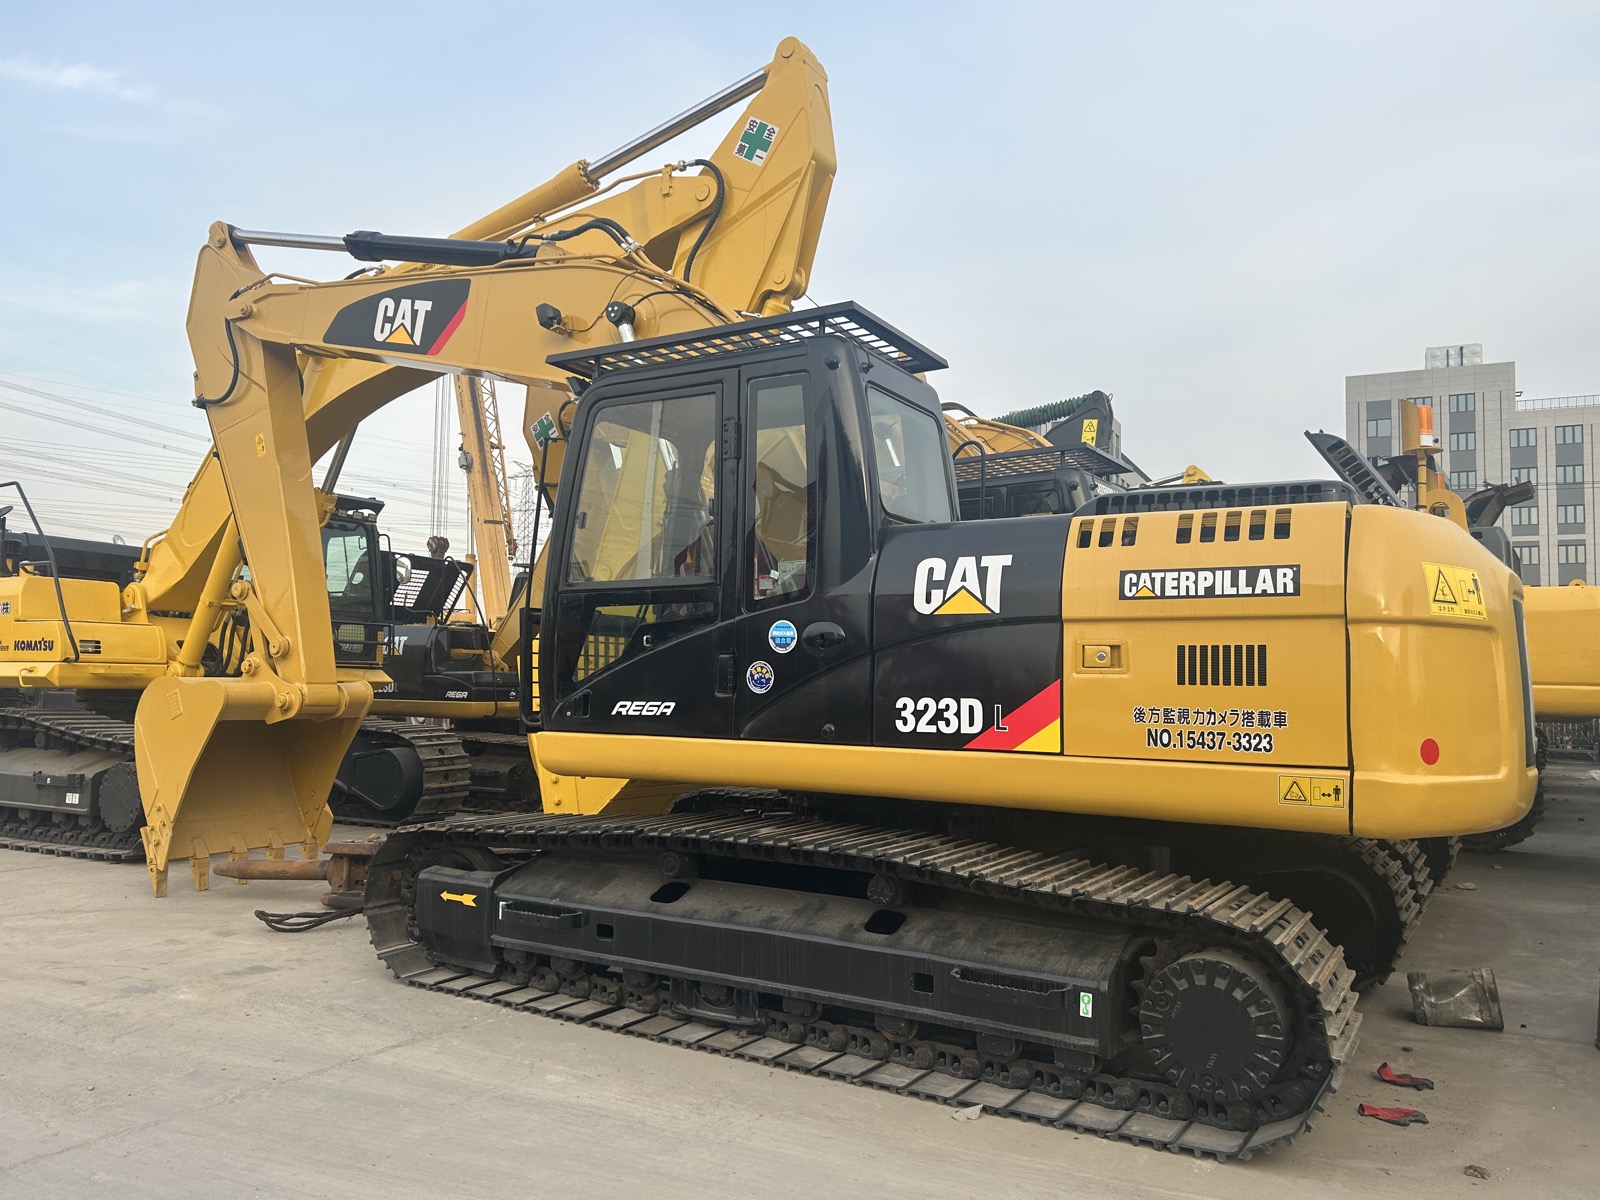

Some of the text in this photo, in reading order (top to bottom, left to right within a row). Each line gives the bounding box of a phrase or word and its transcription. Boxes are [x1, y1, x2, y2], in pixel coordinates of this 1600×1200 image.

[373, 297, 433, 346] CAT
[913, 554, 1013, 615] CAT
[1124, 568, 1295, 598] CATERPILLAR
[14, 637, 54, 651] KOMATSU
[445, 690, 468, 699] REGA
[611, 700, 676, 716] REGA
[895, 696, 1008, 734] 323D L
[1147, 728, 1273, 753] NO.15437-3323
